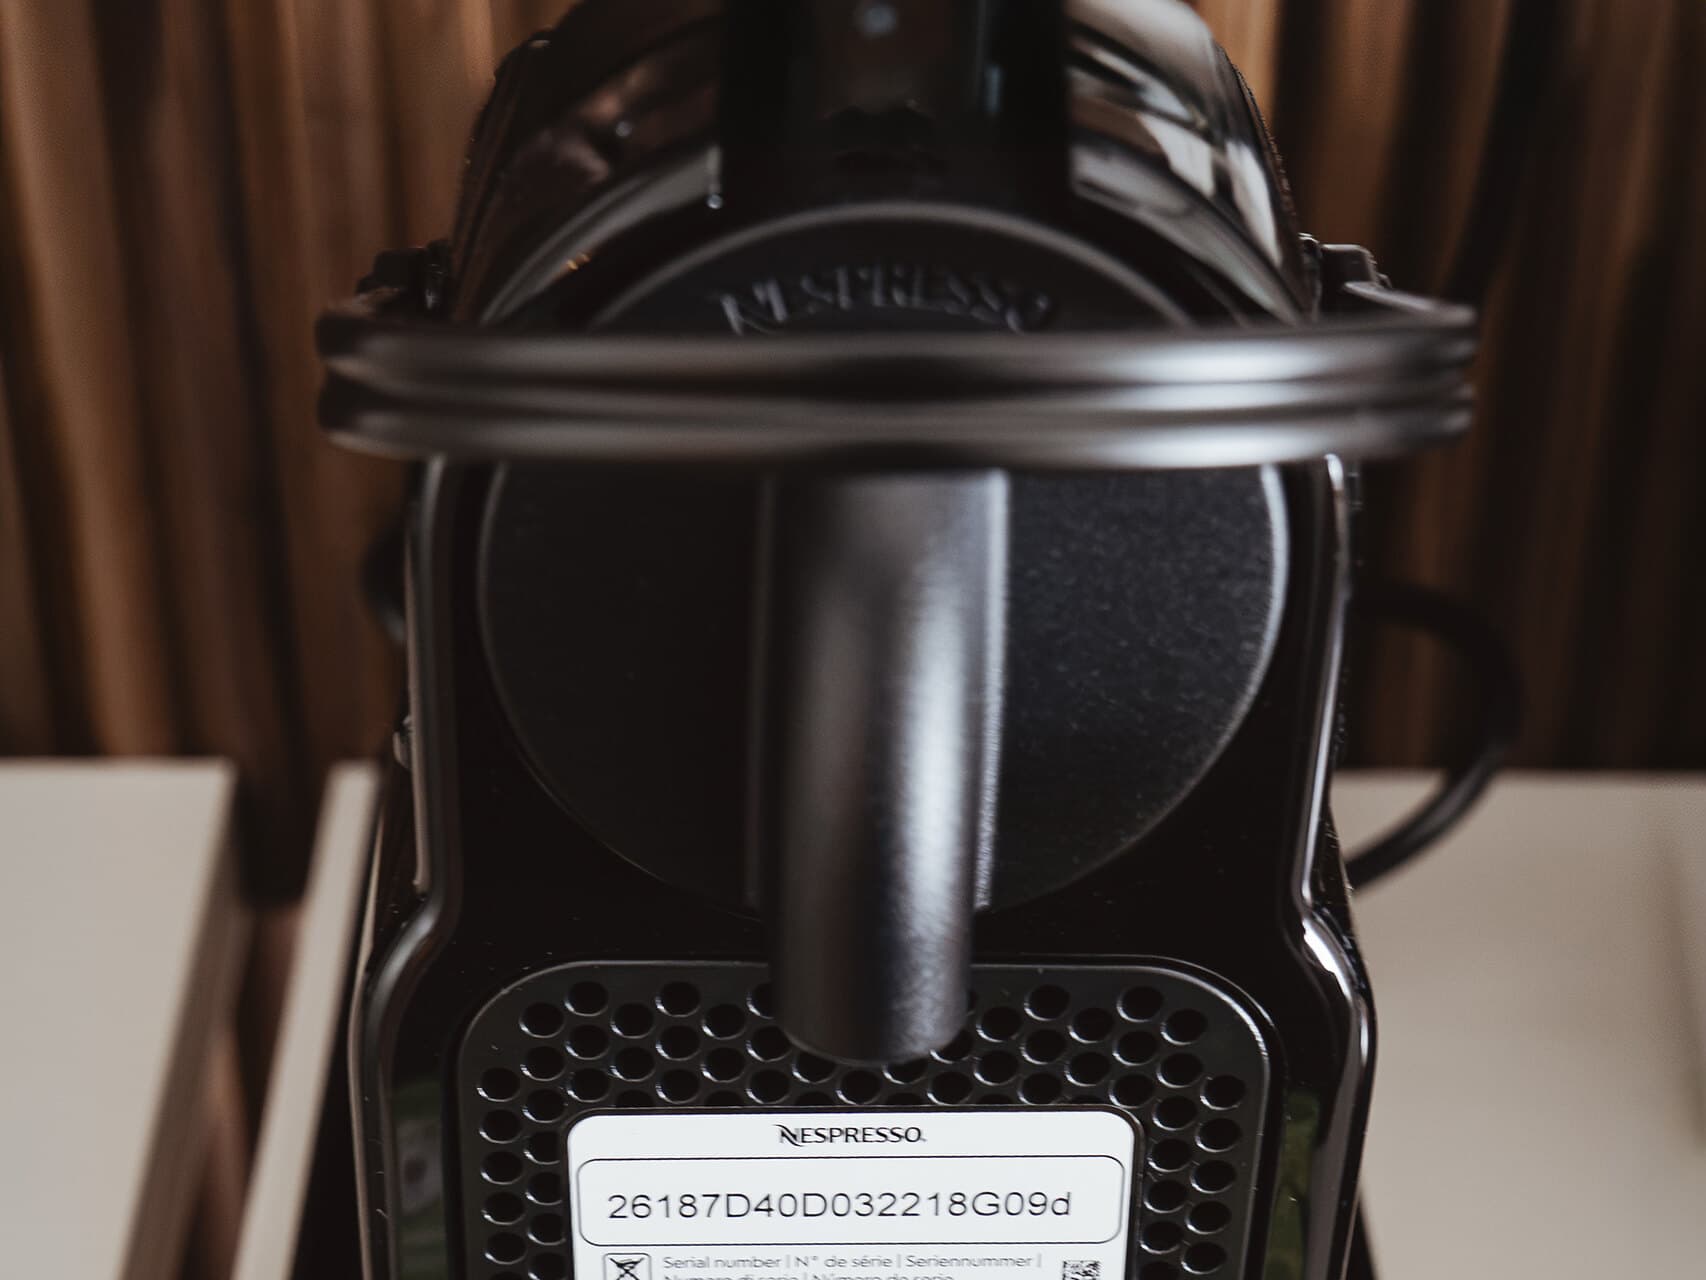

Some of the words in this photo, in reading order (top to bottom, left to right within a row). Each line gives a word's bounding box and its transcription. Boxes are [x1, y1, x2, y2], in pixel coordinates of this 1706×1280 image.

[776, 1124, 924, 1147] NESPRESSO
[608, 1191, 1072, 1220] 26187D40D032218G09d
[663, 1256, 710, 1269] Serial
[714, 1256, 781, 1269] number
[824, 1255, 847, 1269] de
[852, 1253, 893, 1268] série
[906, 1254, 1033, 1268] Seriennummer
